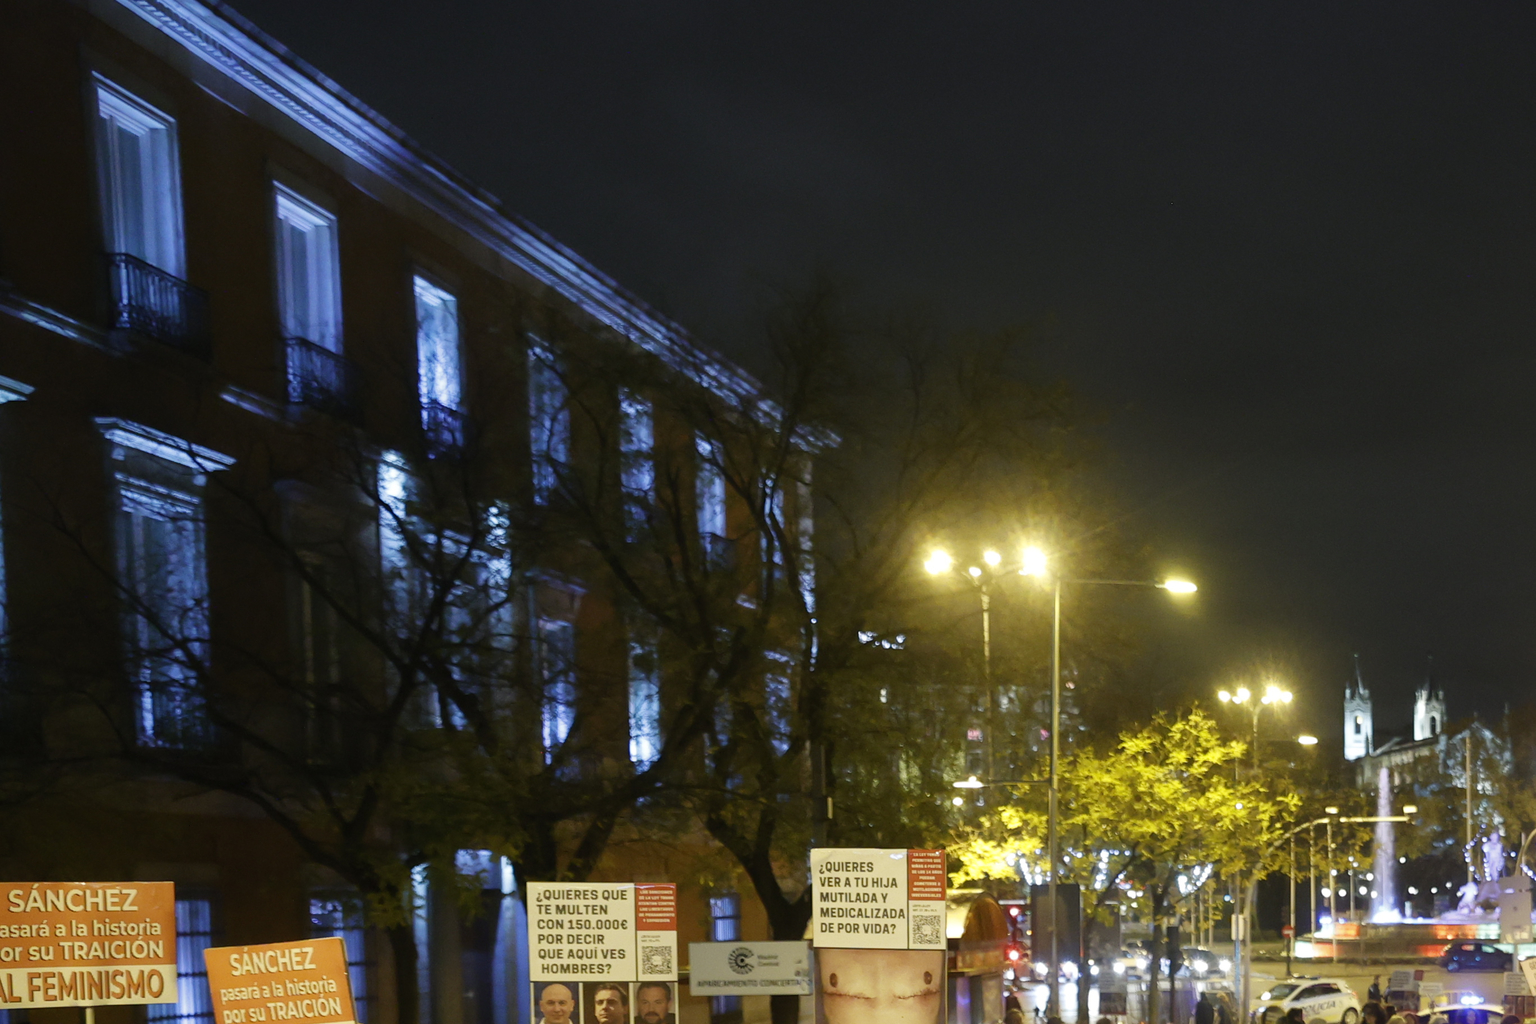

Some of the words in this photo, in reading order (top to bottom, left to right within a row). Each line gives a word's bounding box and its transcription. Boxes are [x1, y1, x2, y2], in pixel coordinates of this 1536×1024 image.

[819, 862, 874, 874] ¿QUIERES
[819, 877, 841, 887] VER
[844, 877, 851, 887] A
[854, 877, 869, 888] TU
[872, 878, 898, 888] HIJA
[8, 884, 139, 913] SÁNCHEZ
[535, 889, 599, 903] ¿QUIERES
[601, 889, 628, 901] QUE
[820, 892, 878, 903] MUTILADA
[880, 893, 888, 903] Y
[536, 904, 552, 915] TE
[555, 905, 608, 915] MULTEN
[820, 908, 905, 919] MEDICALIZADA
[0, 920, 50, 937] asará
[55, 924, 66, 937] a
[71, 920, 88, 936] la
[93, 918, 161, 936] historia
[537, 919, 564, 930] CON
[567, 919, 628, 930] 150.000€
[820, 923, 834, 933] DE
[837, 923, 860, 933] POR
[862, 924, 896, 934] VIDA?
[537, 934, 564, 945] POR
[567, 934, 605, 945] DECIR
[0, 946, 23, 962] or
[28, 946, 54, 961] su
[59, 937, 164, 960] TRAICIÓN
[538, 948, 564, 960] QUE
[567, 946, 598, 960] AQUÍ
[601, 949, 626, 960] VES
[230, 947, 317, 977] SÁNCHEZ
[541, 963, 612, 974] HOMBRES?
[27, 969, 164, 1002] FEMINISMO
[220, 982, 260, 1005] pasará
[262, 986, 271, 998] a
[272, 981, 284, 998] la
[286, 975, 337, 997] historia
[249, 1008, 266, 1023] su
[266, 994, 343, 1021] TRAICIÓN
